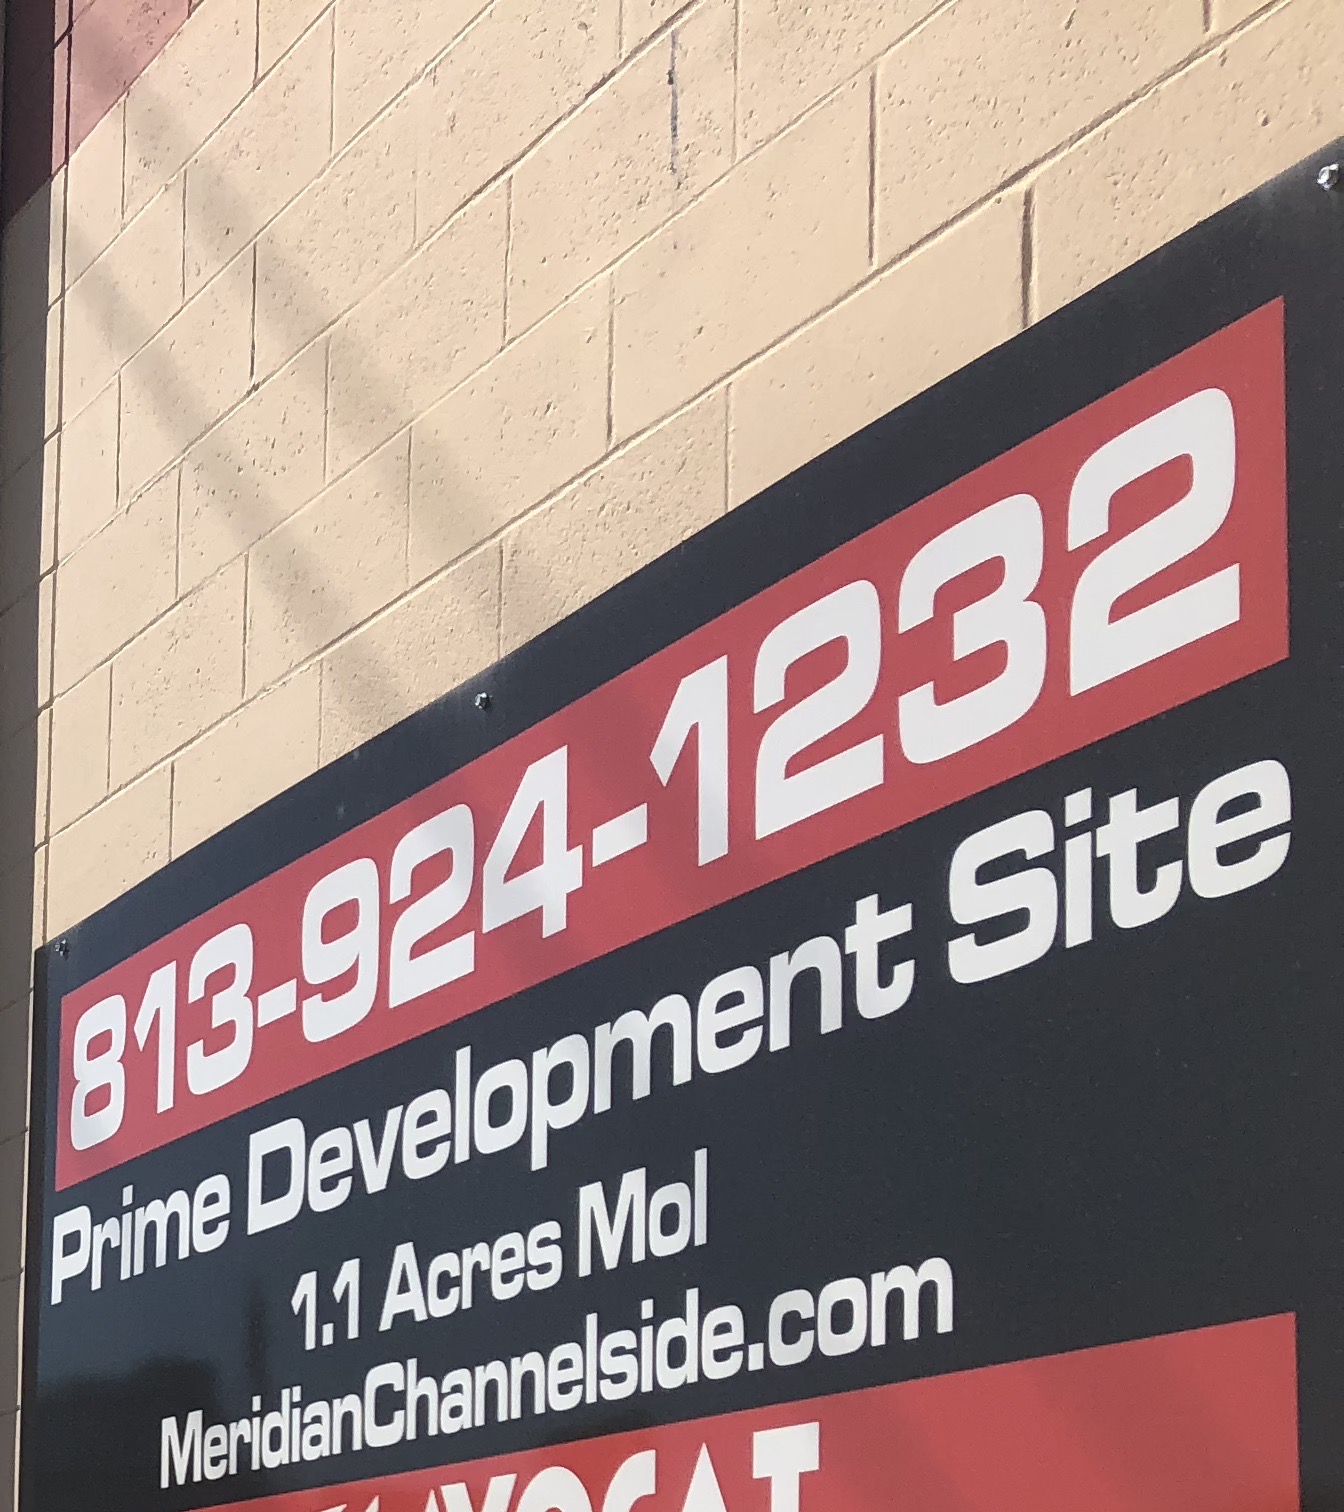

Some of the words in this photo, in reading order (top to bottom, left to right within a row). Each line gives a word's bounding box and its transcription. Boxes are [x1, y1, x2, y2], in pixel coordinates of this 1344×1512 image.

[69, 387, 1241, 1151] 813-924-1232
[50, 1174, 231, 1306] Prime
[246, 893, 916, 1236] Development
[947, 759, 1292, 984] Site
[160, 1257, 954, 1489] MeridianChannelside.com
[290, 1258, 360, 1351] 1.1
[378, 1220, 563, 1332] Acres
[578, 1147, 708, 1278] Mol
